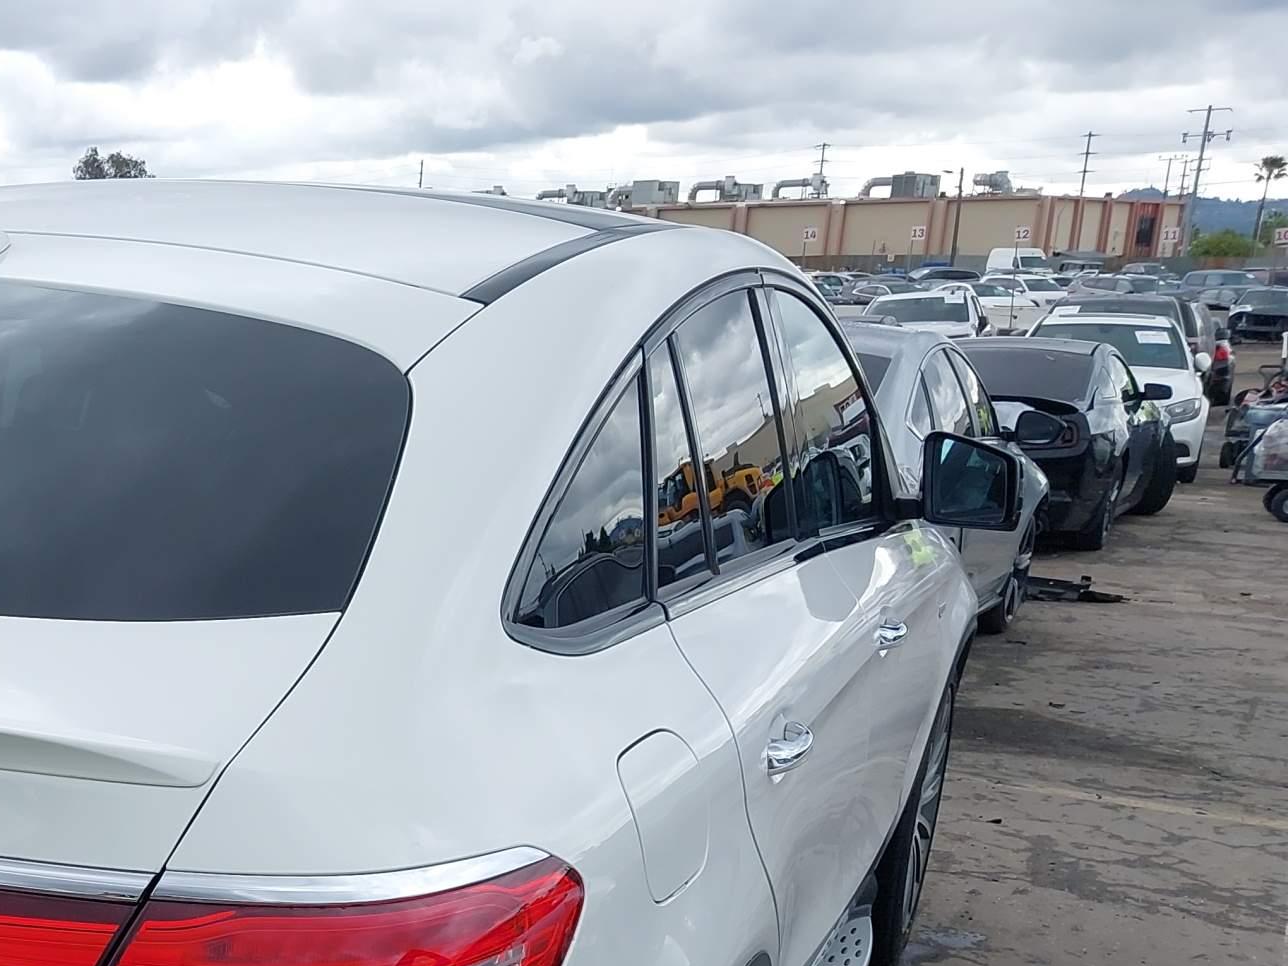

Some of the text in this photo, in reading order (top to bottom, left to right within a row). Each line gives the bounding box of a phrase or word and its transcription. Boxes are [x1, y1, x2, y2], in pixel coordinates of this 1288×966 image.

[804, 230, 816, 240] 14
[911, 228, 925, 238] 13
[1015, 229, 1030, 240] 12
[1163, 230, 1177, 241] 11
